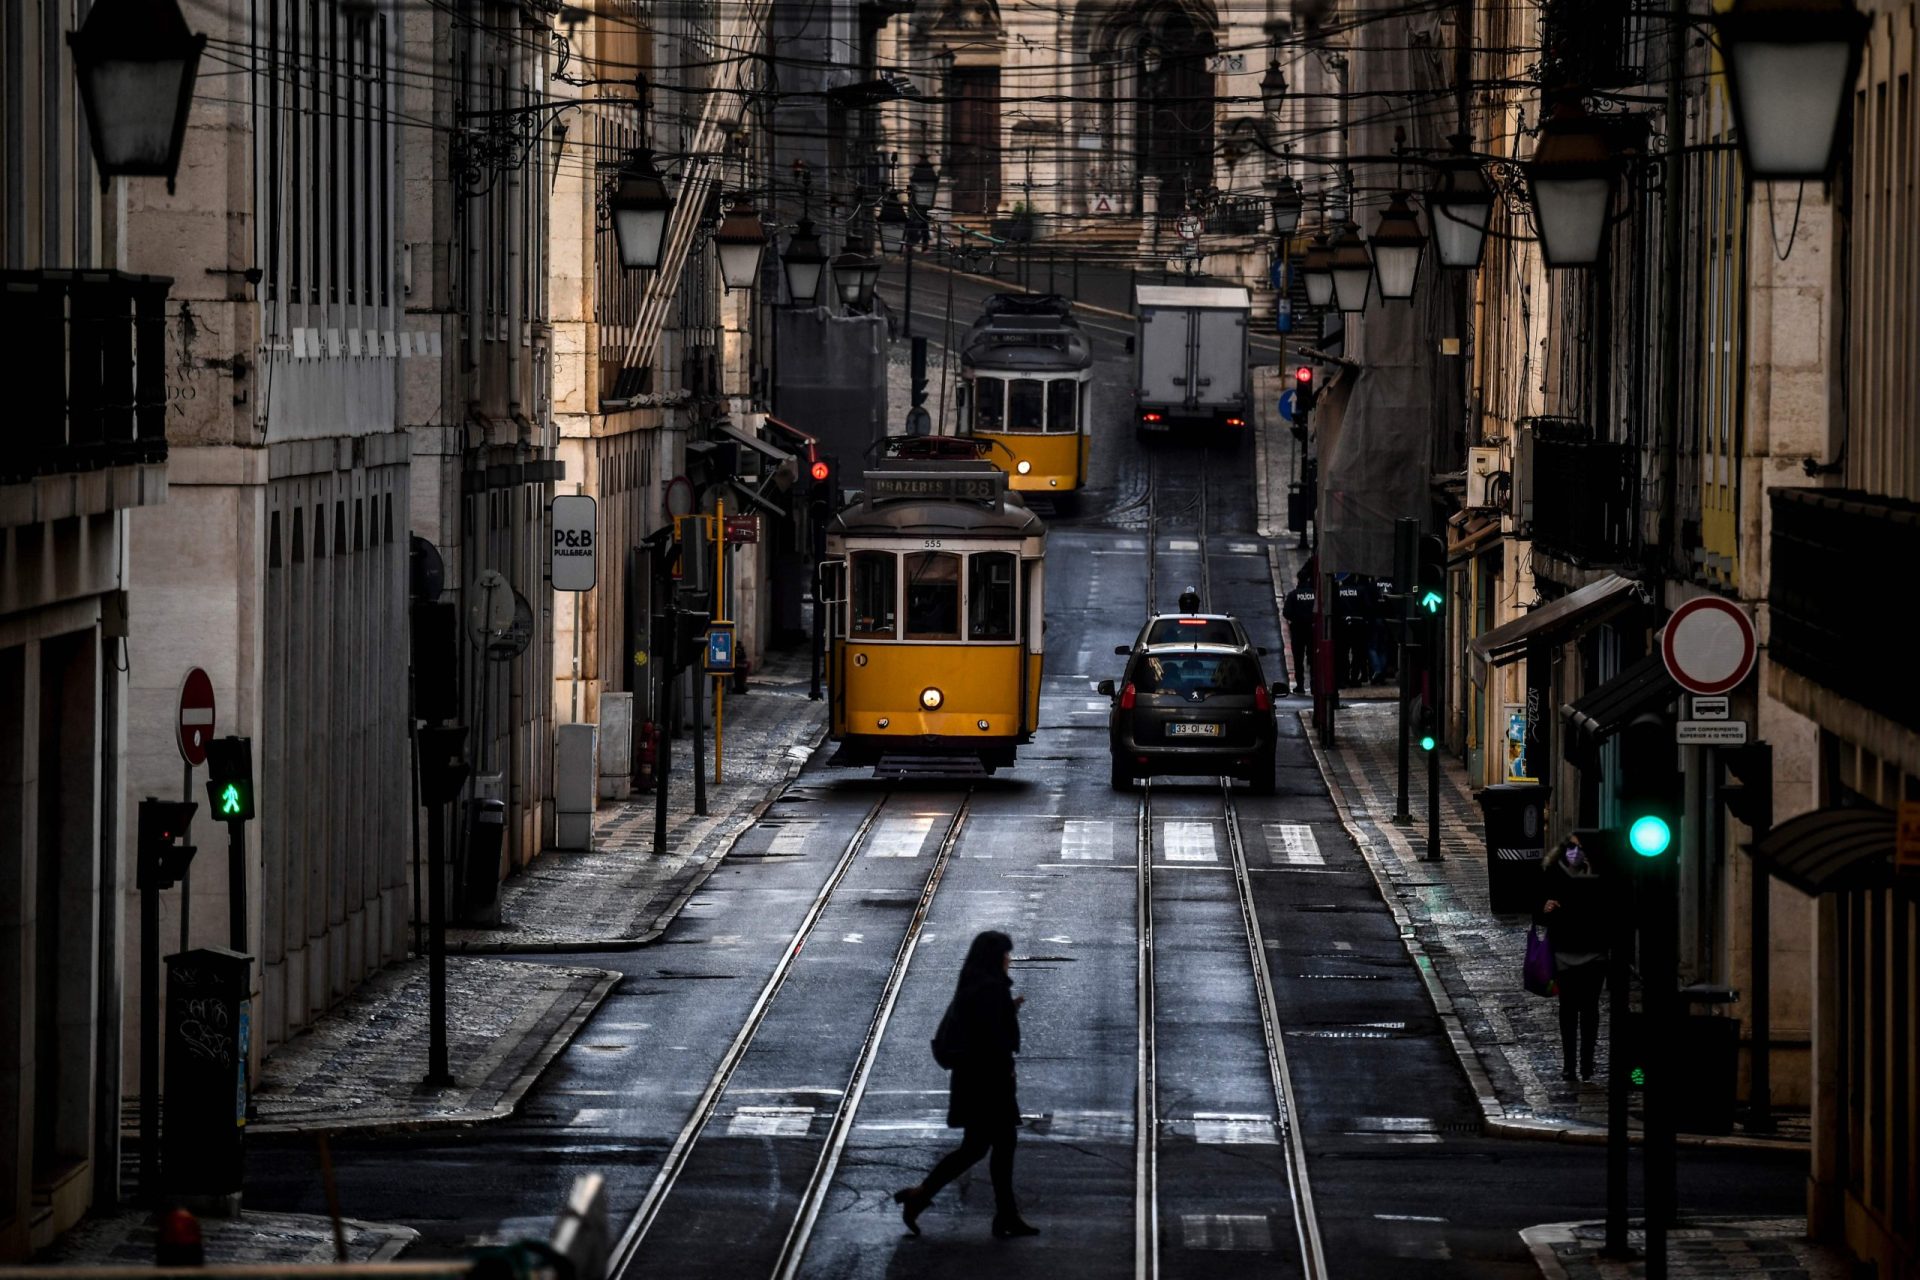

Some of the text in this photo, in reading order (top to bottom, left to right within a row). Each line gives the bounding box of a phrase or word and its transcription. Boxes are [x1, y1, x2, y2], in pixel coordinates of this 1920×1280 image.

[554, 529, 592, 548] P&B
[925, 540, 942, 548] 555
[554, 549, 593, 557] PULL&BEAR
